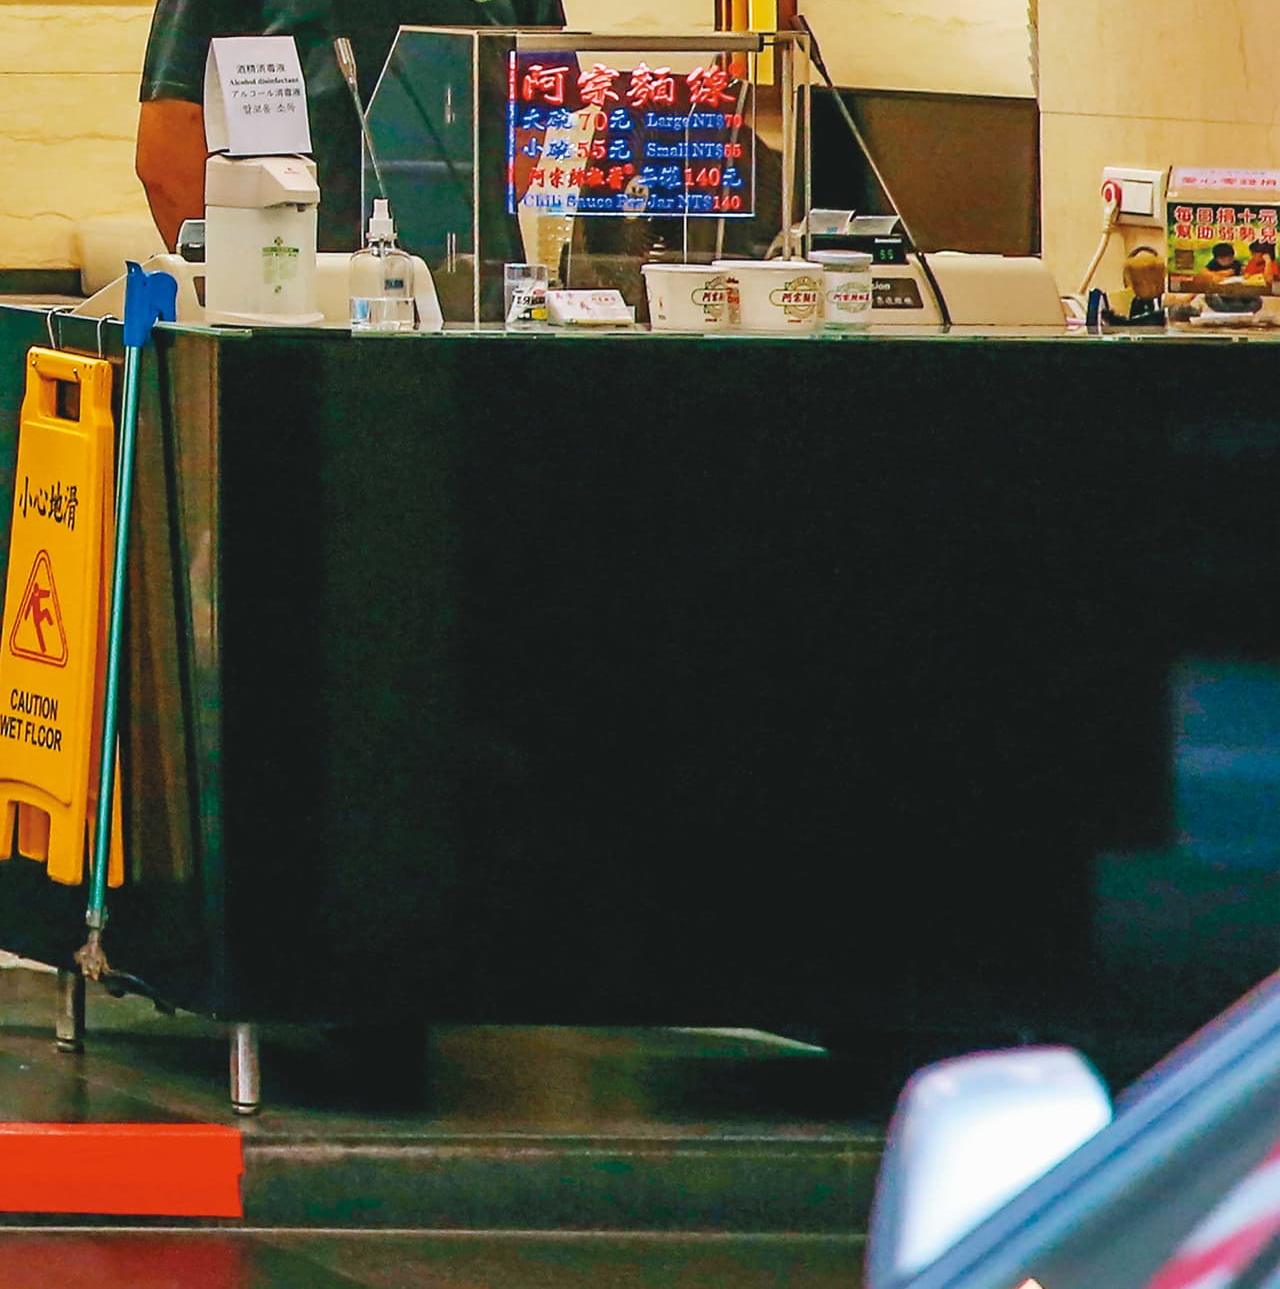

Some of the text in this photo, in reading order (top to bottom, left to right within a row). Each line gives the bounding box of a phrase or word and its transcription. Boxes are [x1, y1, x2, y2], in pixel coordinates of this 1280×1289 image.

[522, 62, 737, 108] 阿宗麵線
[646, 112, 689, 130] Large
[646, 142, 689, 157] Small
[523, 194, 562, 208] Chili
[19, 476, 78, 531] 小心地滑
[10, 689, 58, 721] CAUTION
[0, 714, 62, 751] WET FLOOR
